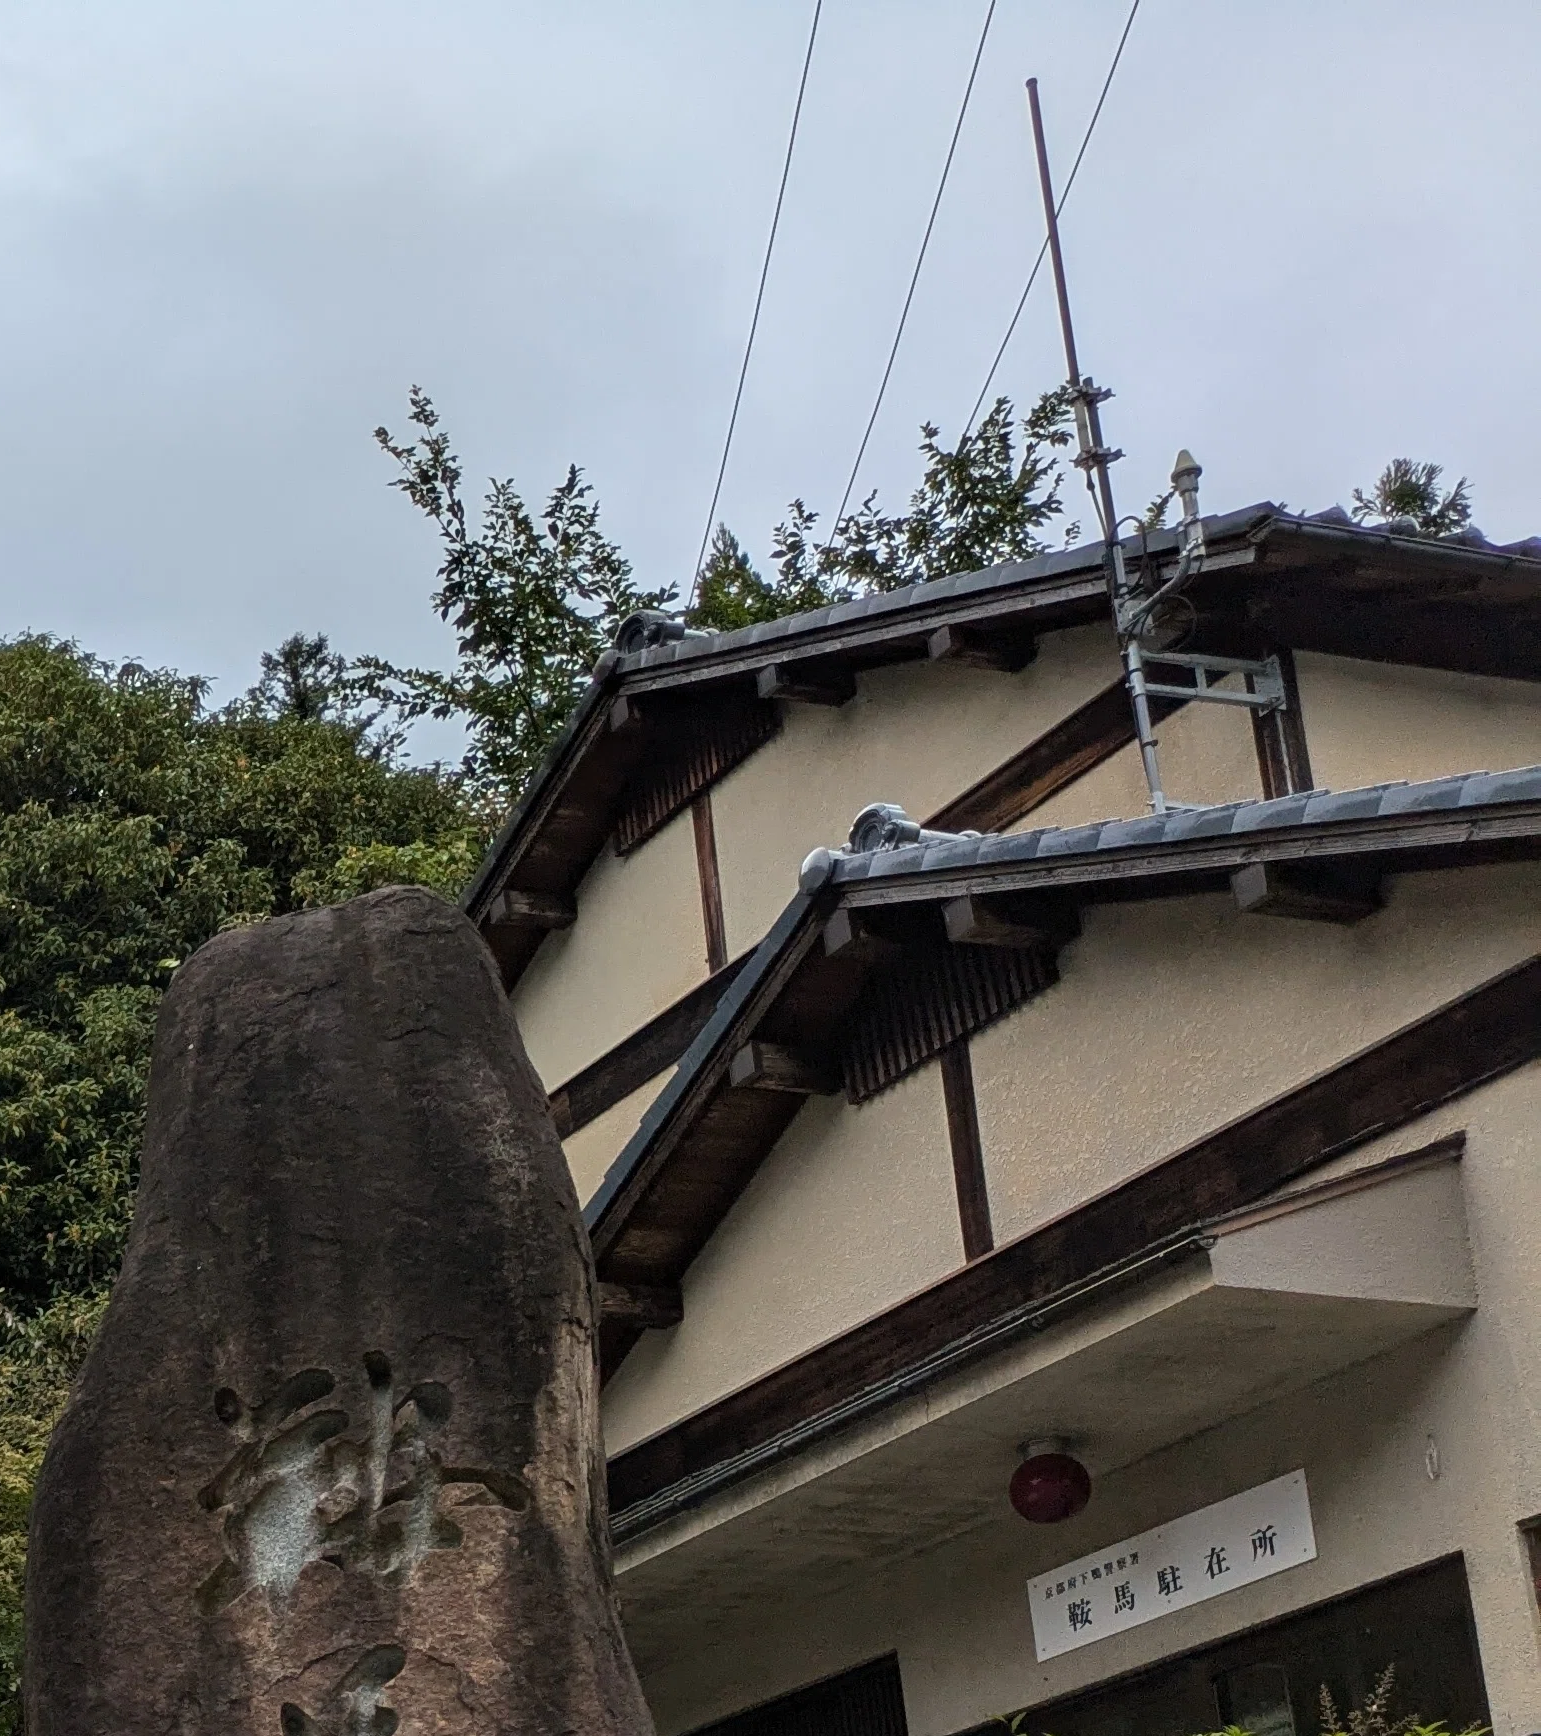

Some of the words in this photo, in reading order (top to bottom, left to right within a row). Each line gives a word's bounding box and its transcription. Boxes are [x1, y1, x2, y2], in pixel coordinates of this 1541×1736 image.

[1066, 1524, 1278, 1632] 鞍馬駐在所
